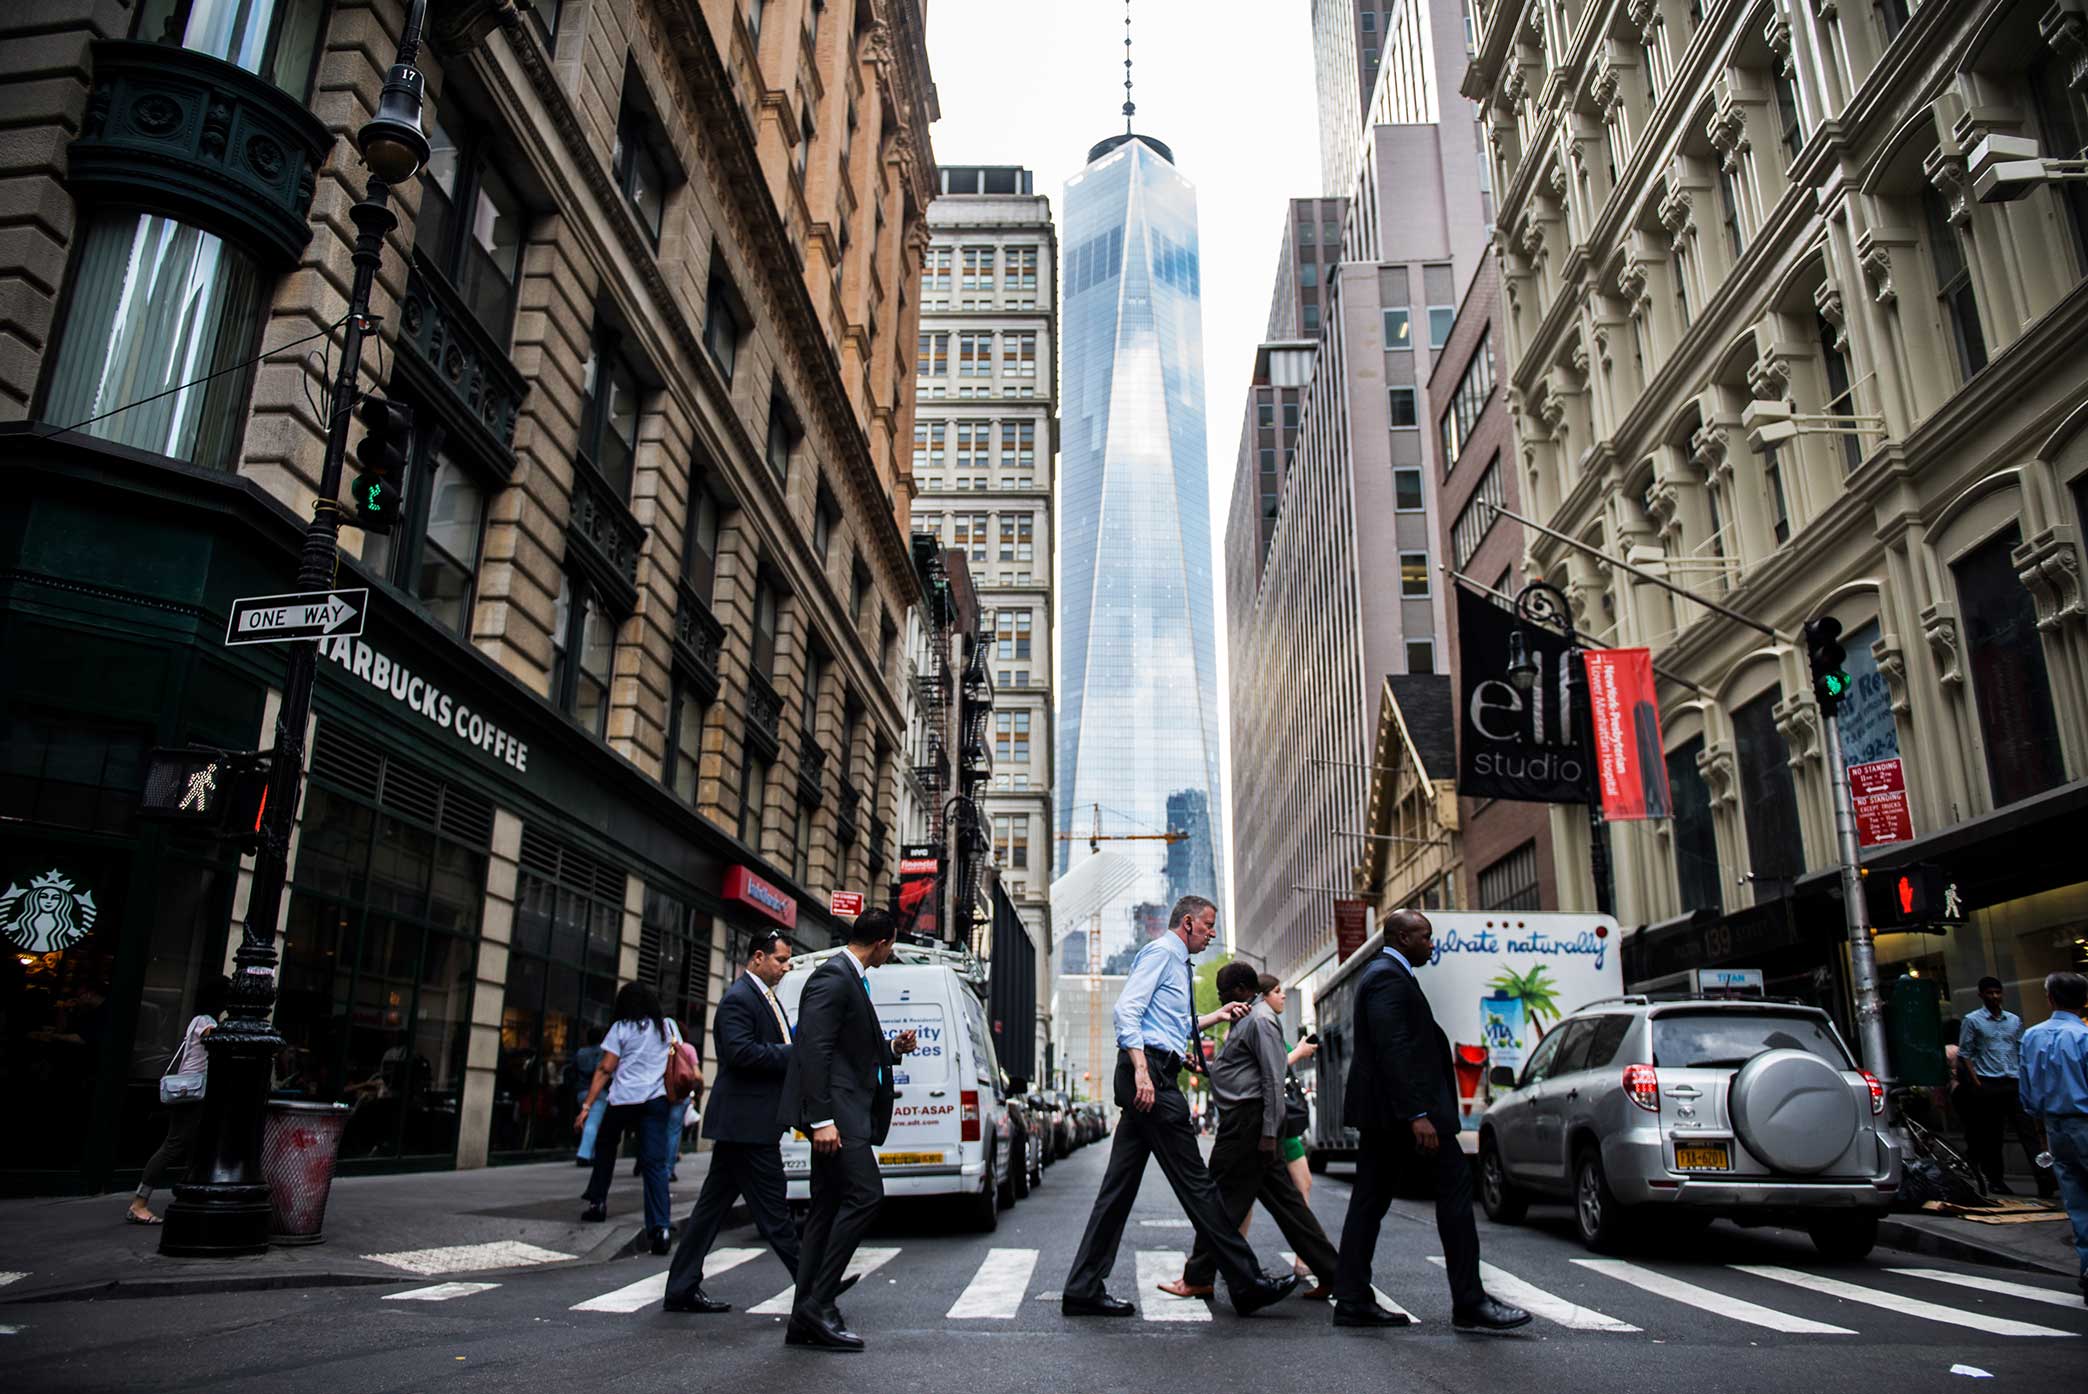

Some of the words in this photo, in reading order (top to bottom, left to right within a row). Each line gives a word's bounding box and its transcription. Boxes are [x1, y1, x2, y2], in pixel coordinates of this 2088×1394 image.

[402, 69, 416, 80] 17
[250, 609, 287, 628] ONE
[304, 605, 344, 624] WAY
[318, 637, 452, 728] ARBUCKS
[455, 705, 528, 772] COFFEE
[1474, 752, 1582, 782] studio
[1852, 768, 1862, 776] NO
[1864, 762, 1898, 774] STANDING
[1857, 798, 1866, 806] NO
[1870, 793, 1902, 804] STANDING
[1430, 929, 1500, 966] ydrate
[1507, 931, 1608, 970] naturally
[1704, 924, 1732, 957] 139
[1485, 1024, 1514, 1040] VITA
